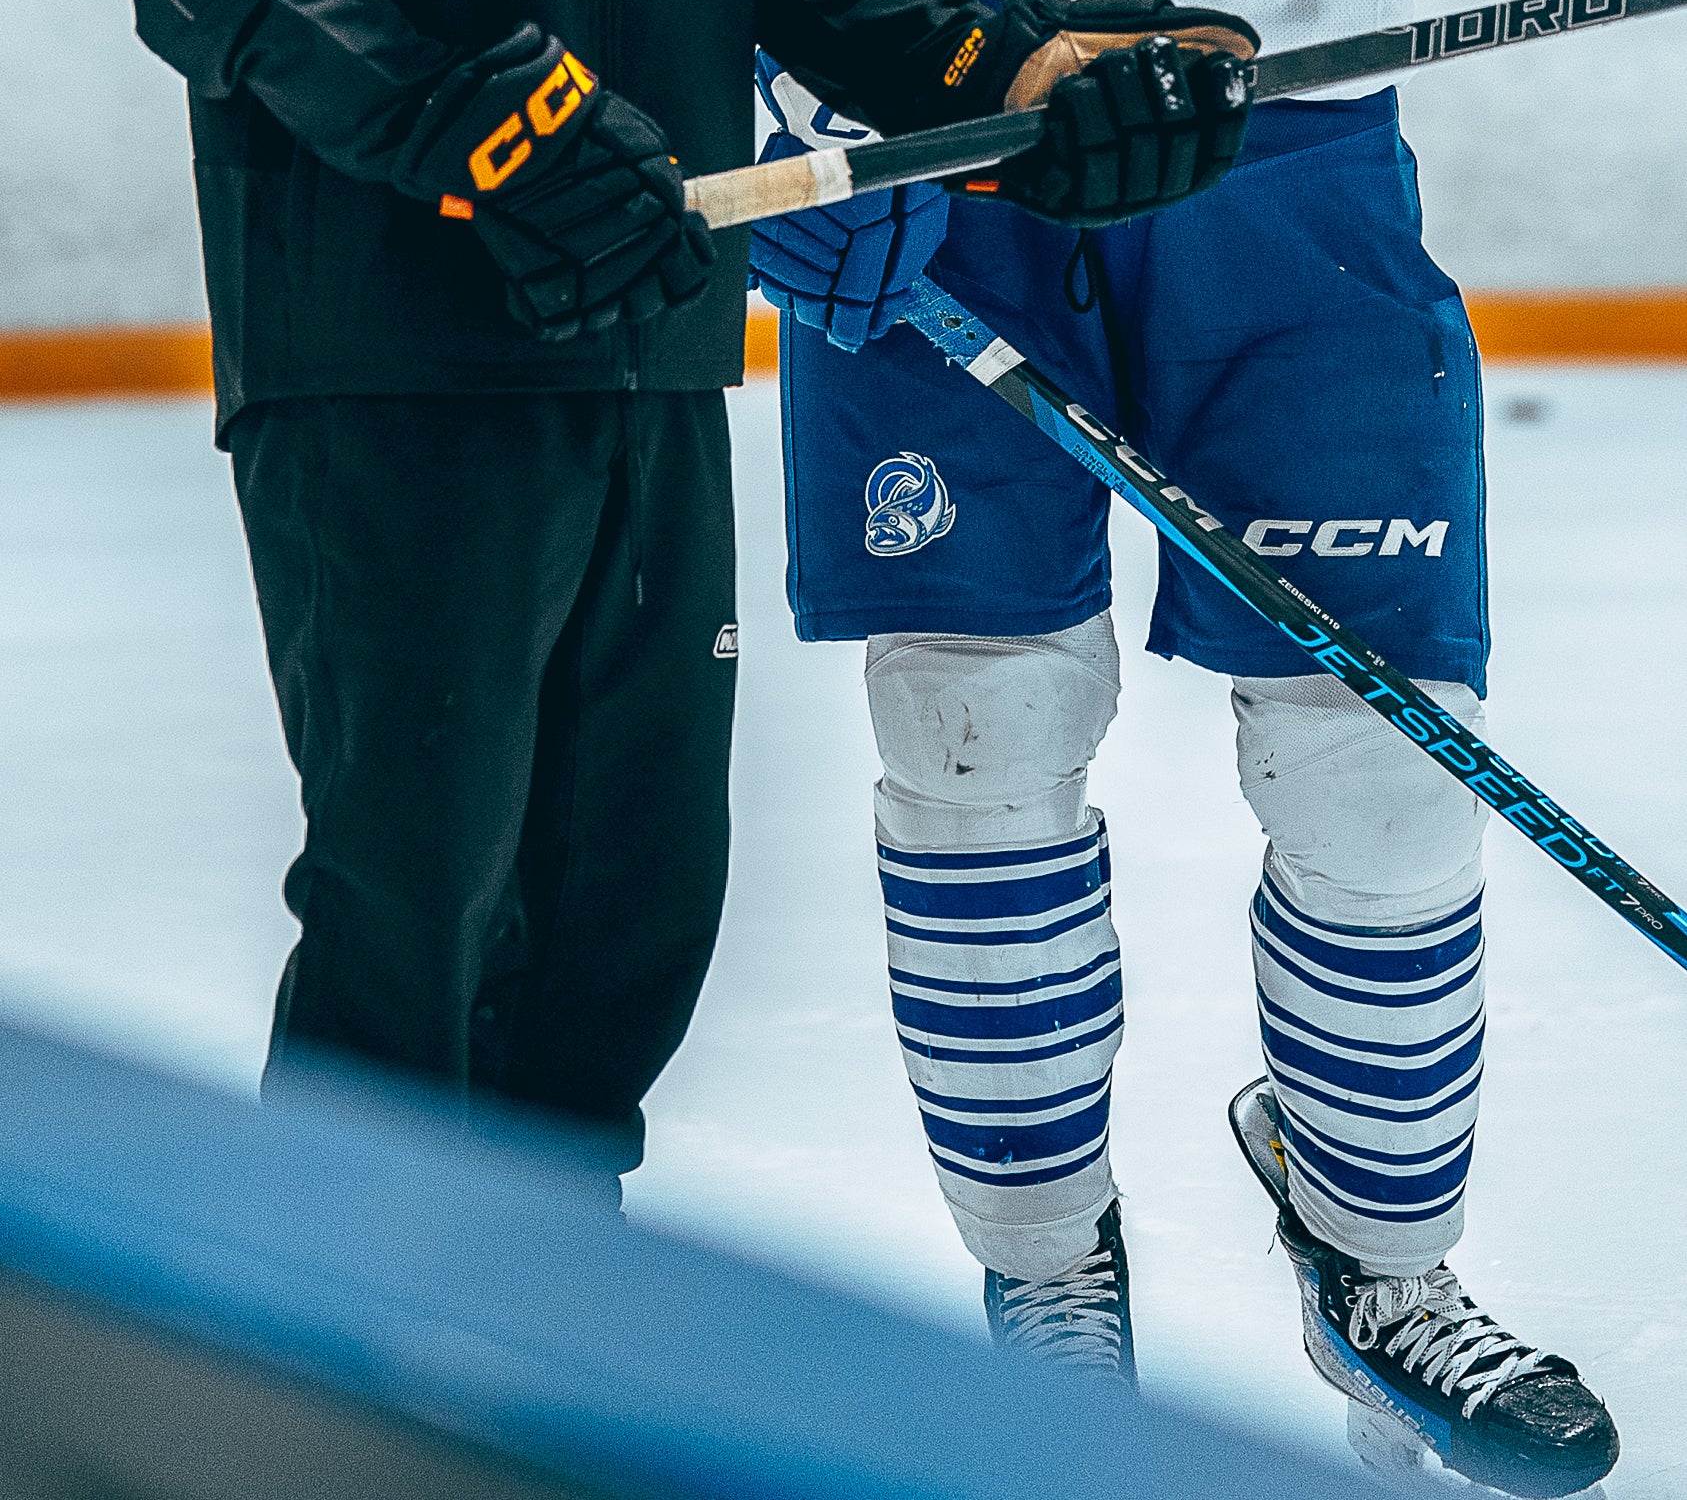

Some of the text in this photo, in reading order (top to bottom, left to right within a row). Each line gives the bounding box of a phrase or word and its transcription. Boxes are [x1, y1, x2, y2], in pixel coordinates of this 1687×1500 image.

[1065, 402, 1225, 532] CCM
[1074, 443, 1128, 489] NANOLITE
[1241, 518, 1450, 558] CCM
[1277, 620, 1588, 869] JETSPEED
